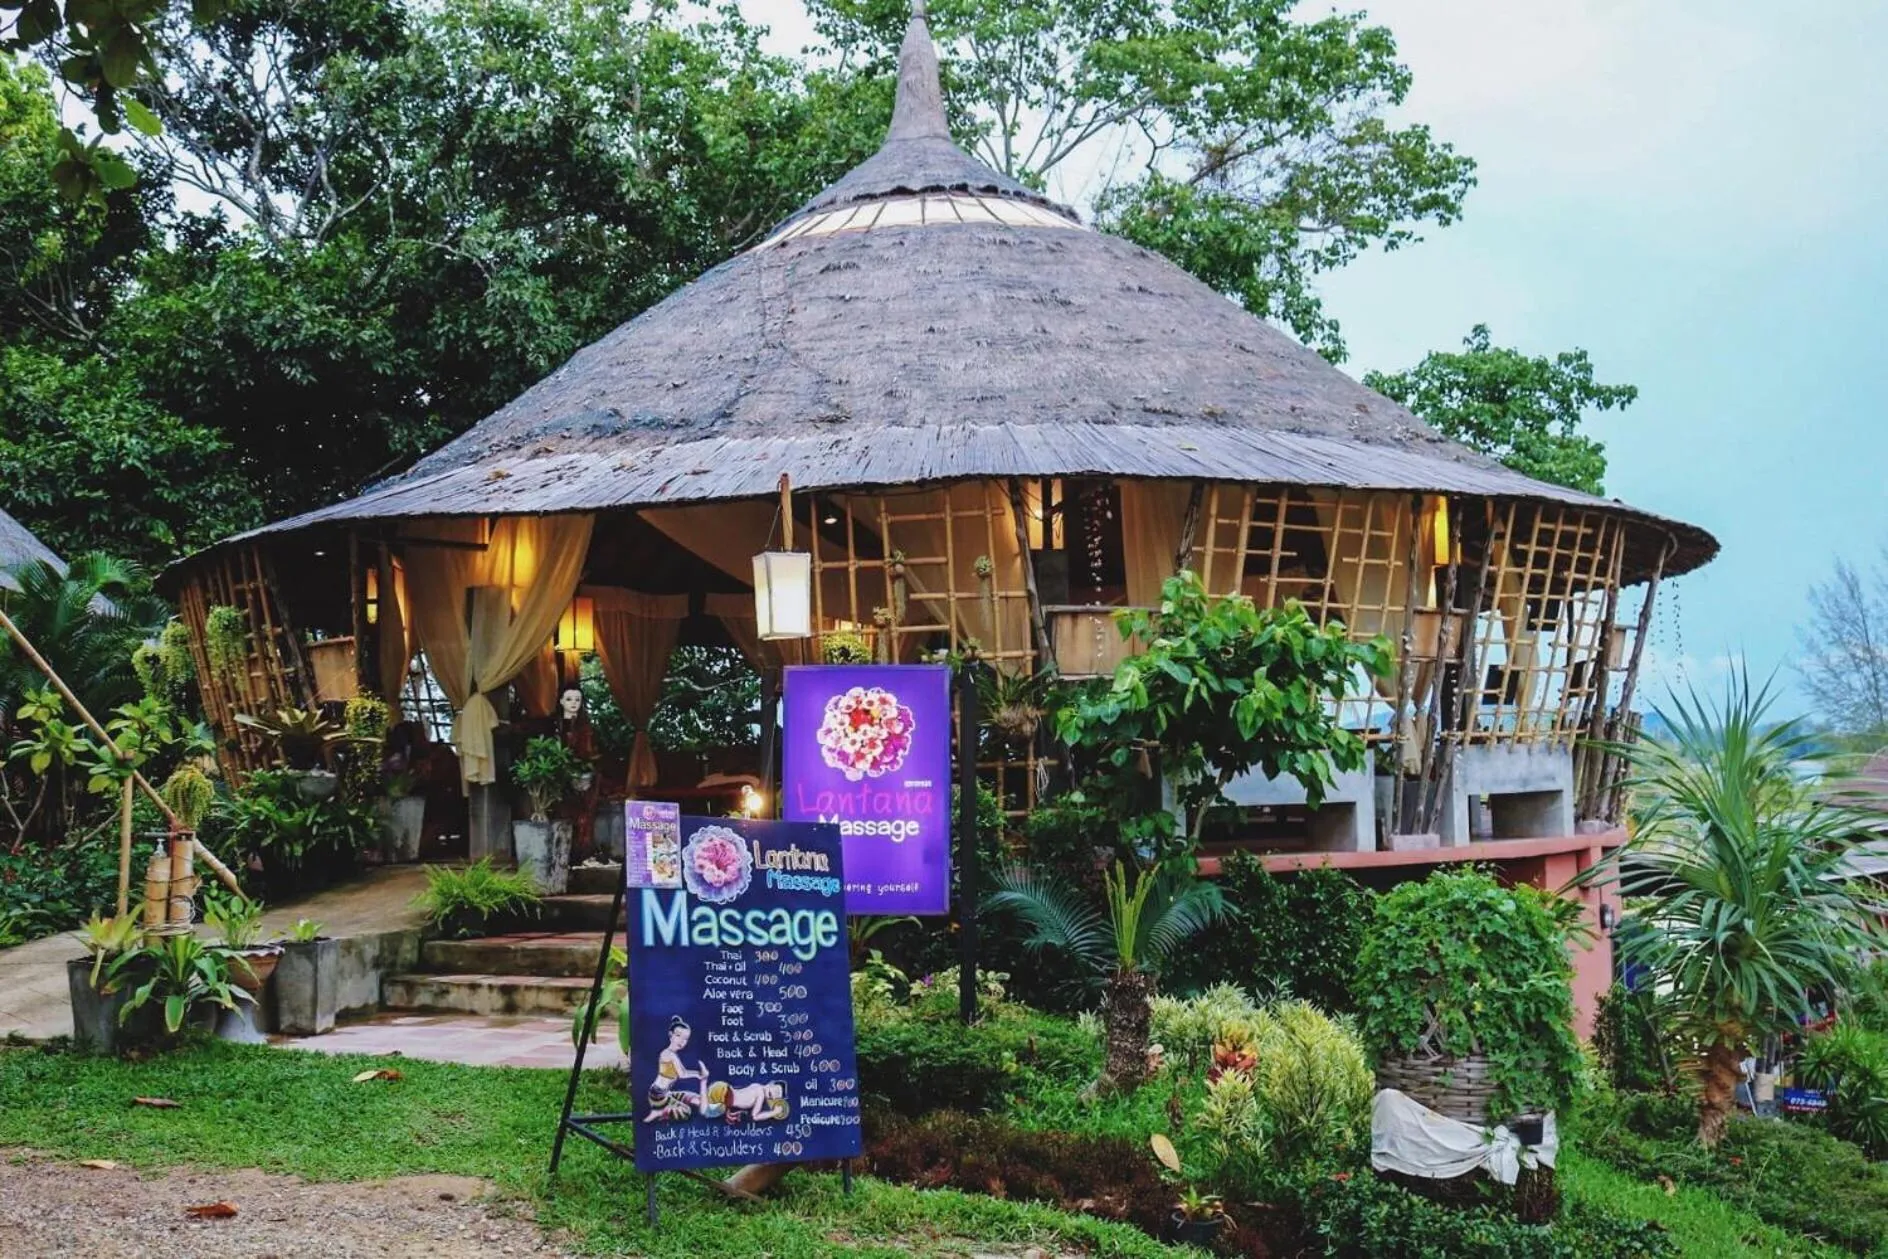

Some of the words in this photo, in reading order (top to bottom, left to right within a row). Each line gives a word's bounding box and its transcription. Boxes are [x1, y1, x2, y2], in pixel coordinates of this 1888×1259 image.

[797, 783, 934, 815] Lantana
[629, 816, 677, 833] Massage
[766, 869, 841, 897] Massage
[641, 889, 839, 961] Massage
[720, 950, 742, 960] Thai
[704, 974, 748, 986] Coconut
[702, 987, 727, 999] Aloe
[729, 989, 754, 1000] vera
[779, 984, 808, 1000] 500
[755, 1001, 783, 1018] 300
[721, 1015, 744, 1027] Foot
[777, 1012, 809, 1029] 300
[708, 1031, 729, 1042] Foot
[732, 1031, 741, 1041] &
[743, 1030, 773, 1042] Scrub
[717, 1046, 743, 1058] Back
[748, 1045, 757, 1057] &
[763, 1045, 788, 1057] Head
[793, 1043, 822, 1058] 400
[728, 1063, 756, 1077] Body
[760, 1061, 768, 1074] &
[771, 1061, 800, 1074] Scrub
[810, 1059, 841, 1073] 600
[828, 1077, 856, 1093] 300
[655, 1127, 677, 1142] Back
[723, 1123, 774, 1138] Shoulders
[786, 1124, 812, 1139] 450
[687, 1140, 700, 1157] &
[700, 1139, 763, 1158] Shoulders
[773, 1141, 803, 1157] 400
